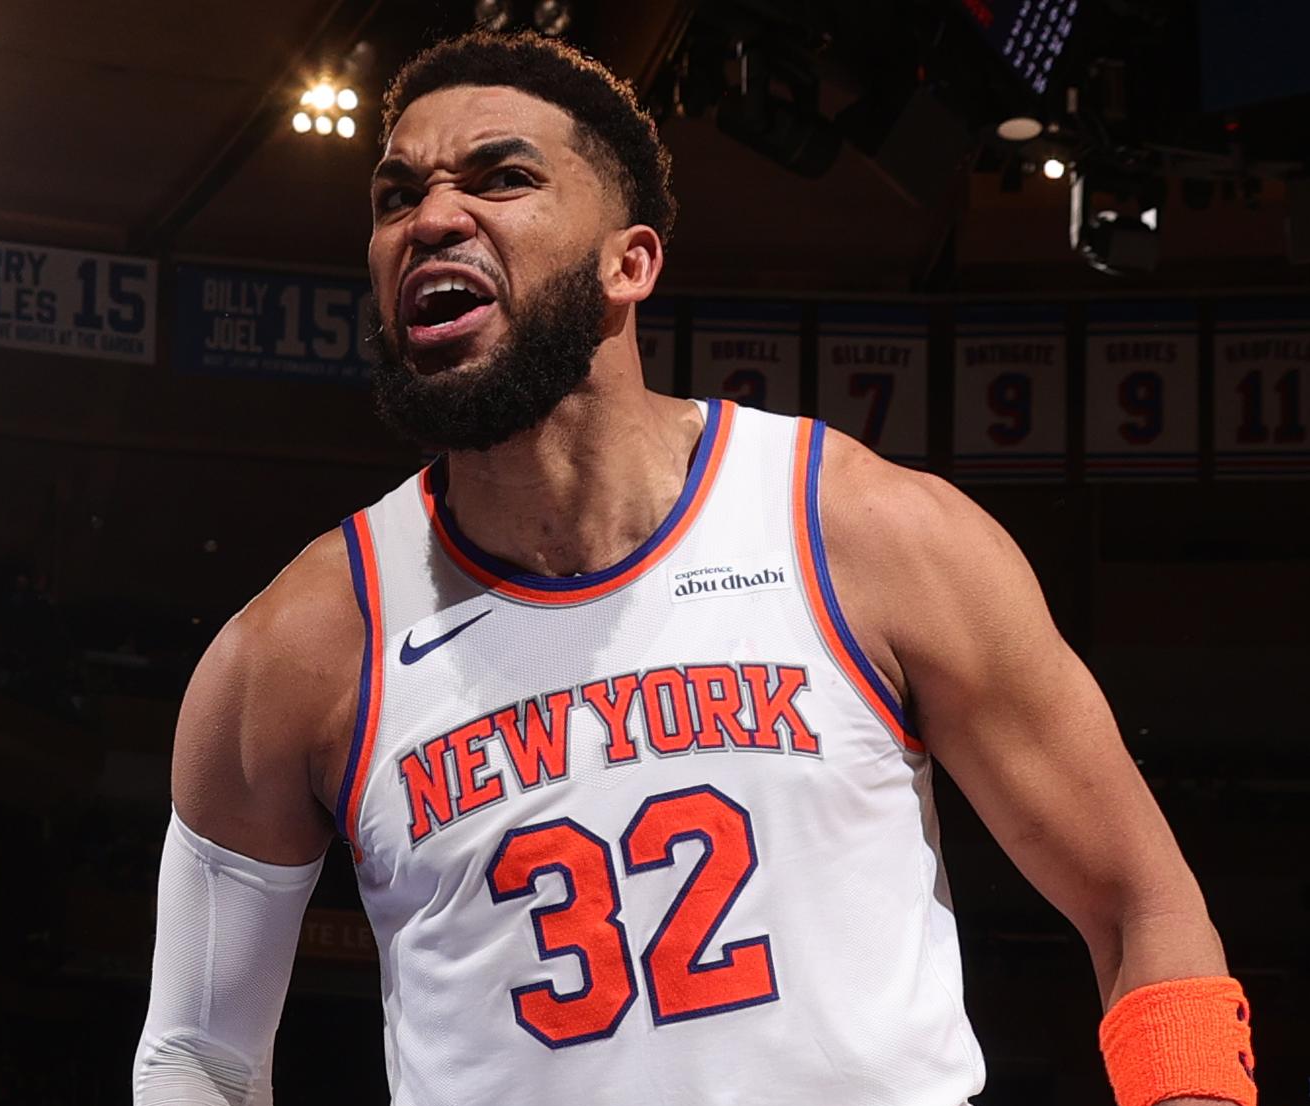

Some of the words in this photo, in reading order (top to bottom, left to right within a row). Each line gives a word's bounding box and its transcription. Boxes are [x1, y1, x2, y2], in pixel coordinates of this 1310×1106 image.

[73, 259, 147, 334] 15
[202, 277, 269, 315] BILLY
[204, 317, 264, 354] JOEL
[849, 372, 895, 446] 7
[987, 372, 1032, 445] 9
[1118, 370, 1164, 444] 9
[1236, 368, 1306, 443] 11
[675, 566, 733, 580] experience
[675, 579, 717, 597] abu
[397, 687, 573, 850] NEW
[581, 660, 824, 768] YORK
[486, 784, 780, 1049] 32
